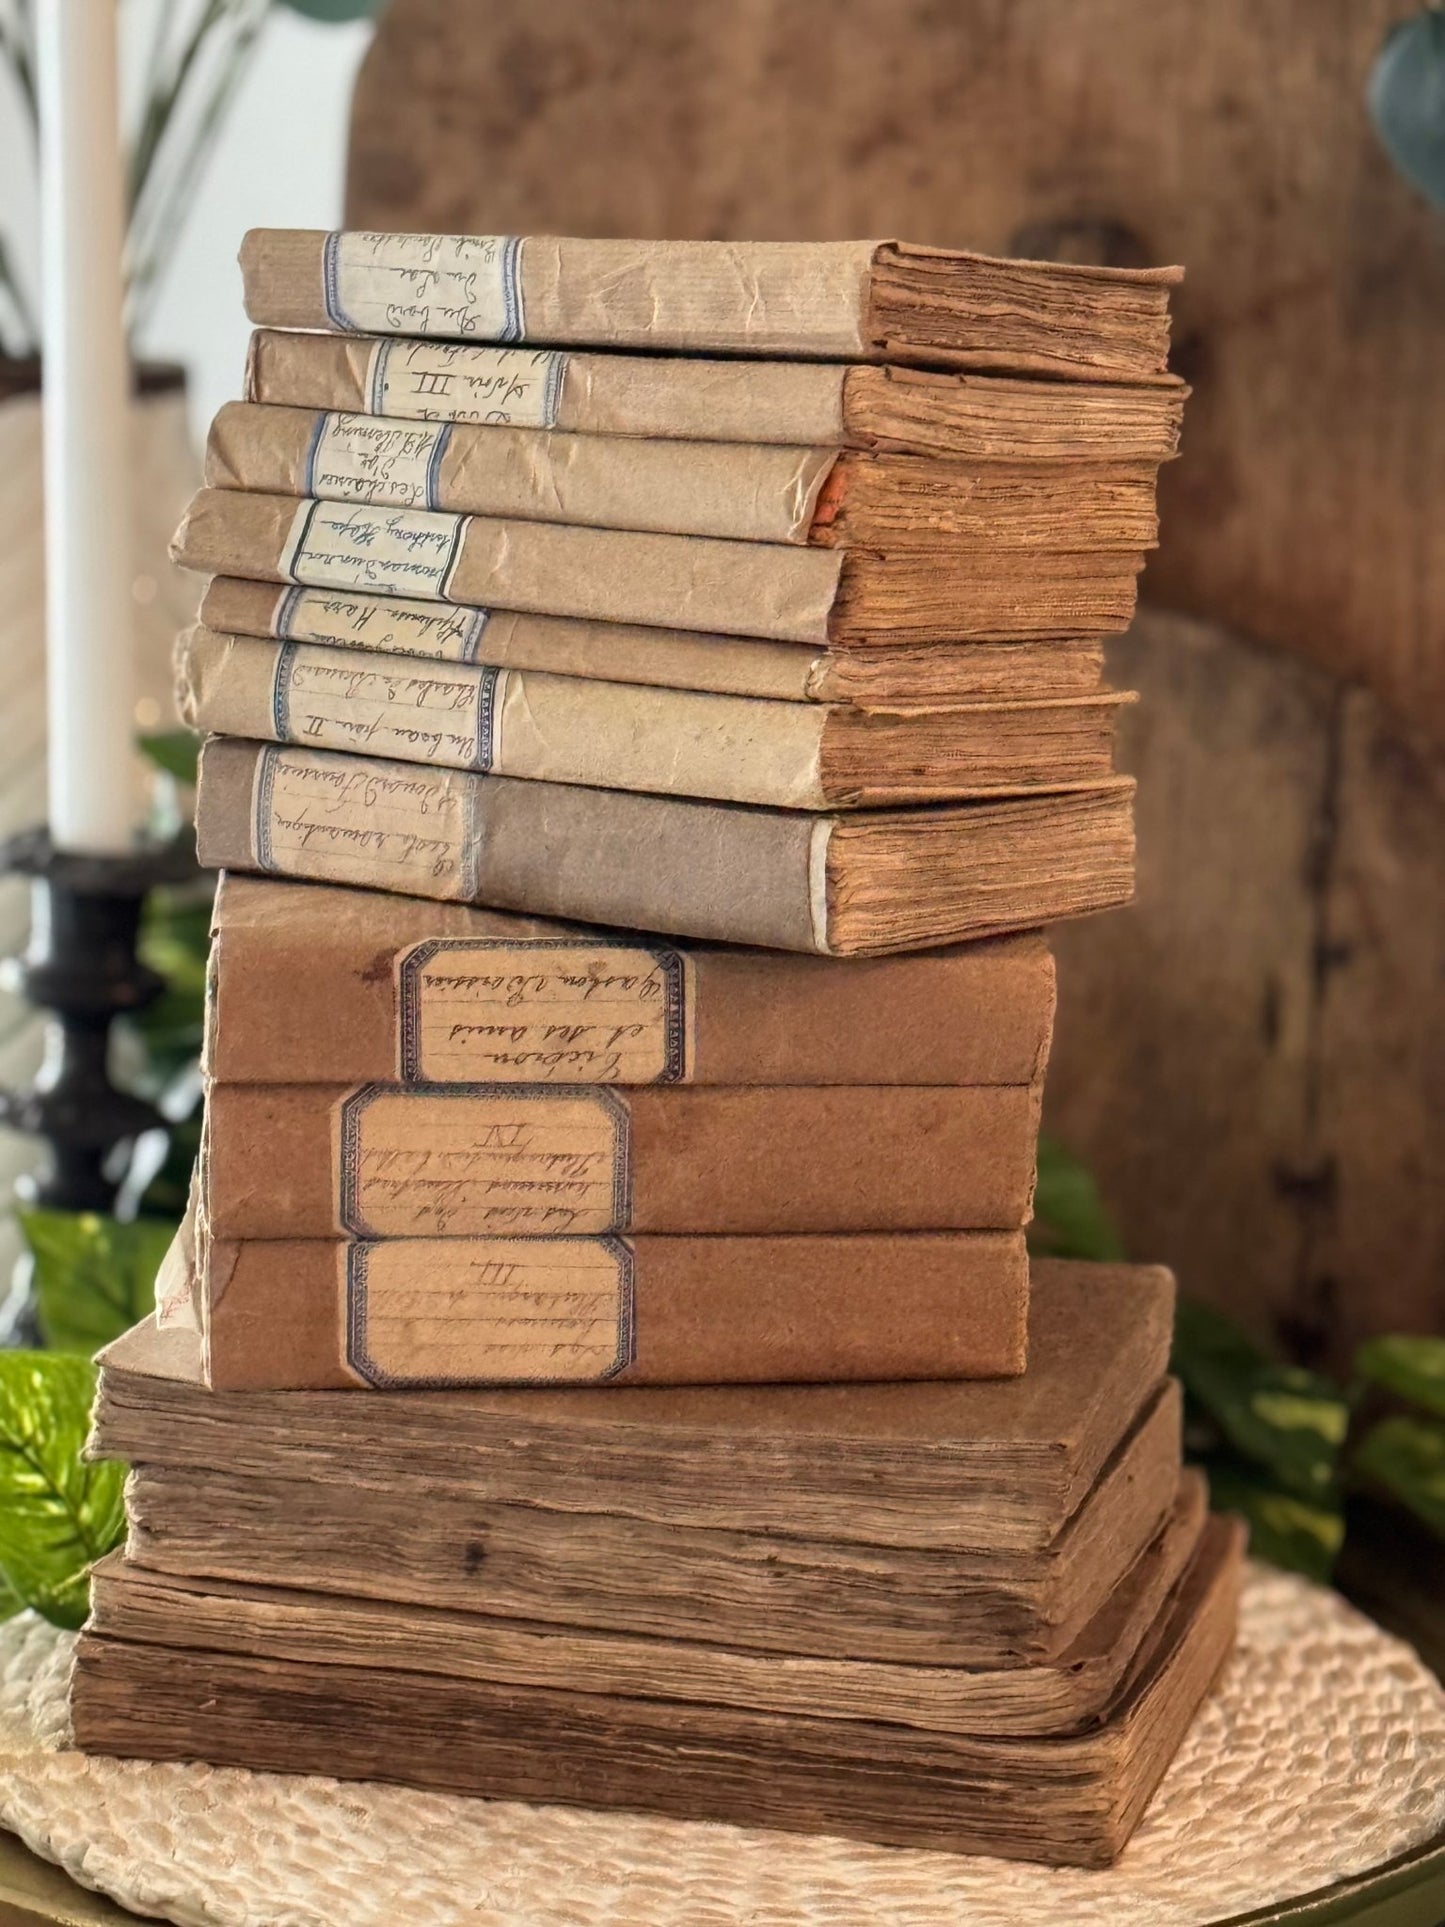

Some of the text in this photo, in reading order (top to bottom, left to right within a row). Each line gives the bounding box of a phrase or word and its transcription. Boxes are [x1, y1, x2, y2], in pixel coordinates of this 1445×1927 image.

[411, 372, 457, 396] III
[408, 680, 477, 710] Charles
[303, 715, 329, 737] II
[422, 964, 661, 1008] Gaston Boissier
[449, 1024, 645, 1049] et ses amis
